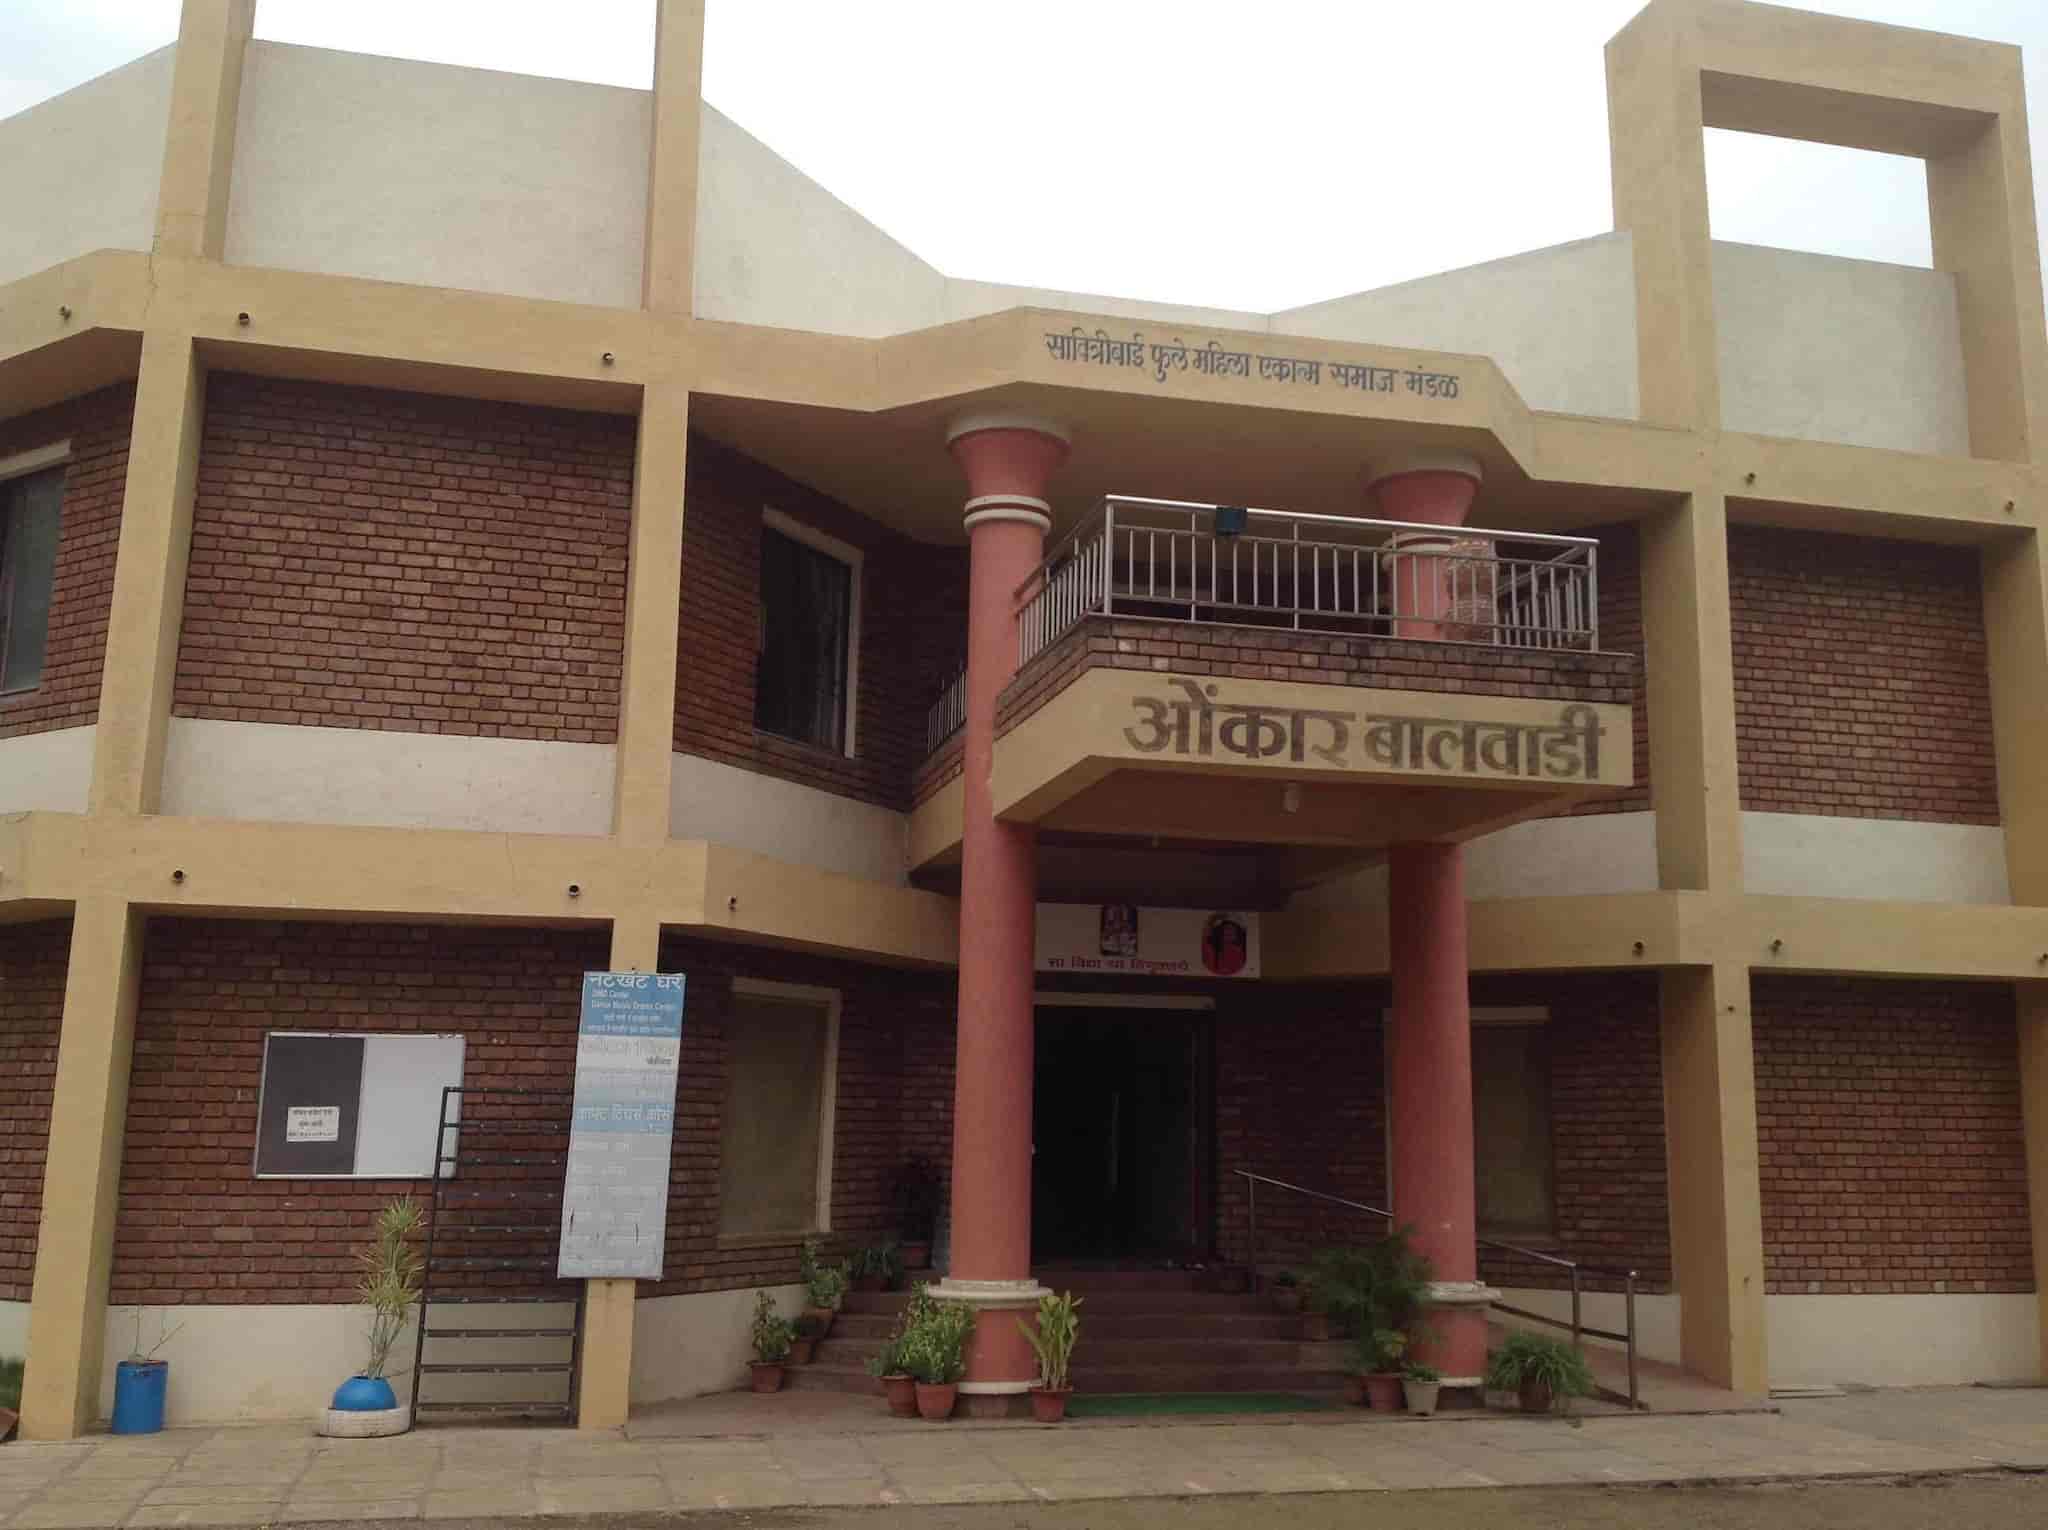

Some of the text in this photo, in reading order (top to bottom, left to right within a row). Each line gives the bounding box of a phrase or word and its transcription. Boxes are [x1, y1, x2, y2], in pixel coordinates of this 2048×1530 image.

[1045, 327, 1146, 368] सावित्रीबाई
[1151, 336, 1188, 383] फुले
[1192, 341, 1250, 378] महिला
[1329, 361, 1398, 393] समाज
[1405, 364, 1460, 399] मंडळ
[1122, 676, 1607, 780] ओंकार बालवाडी
[655, 974, 683, 990] घर
